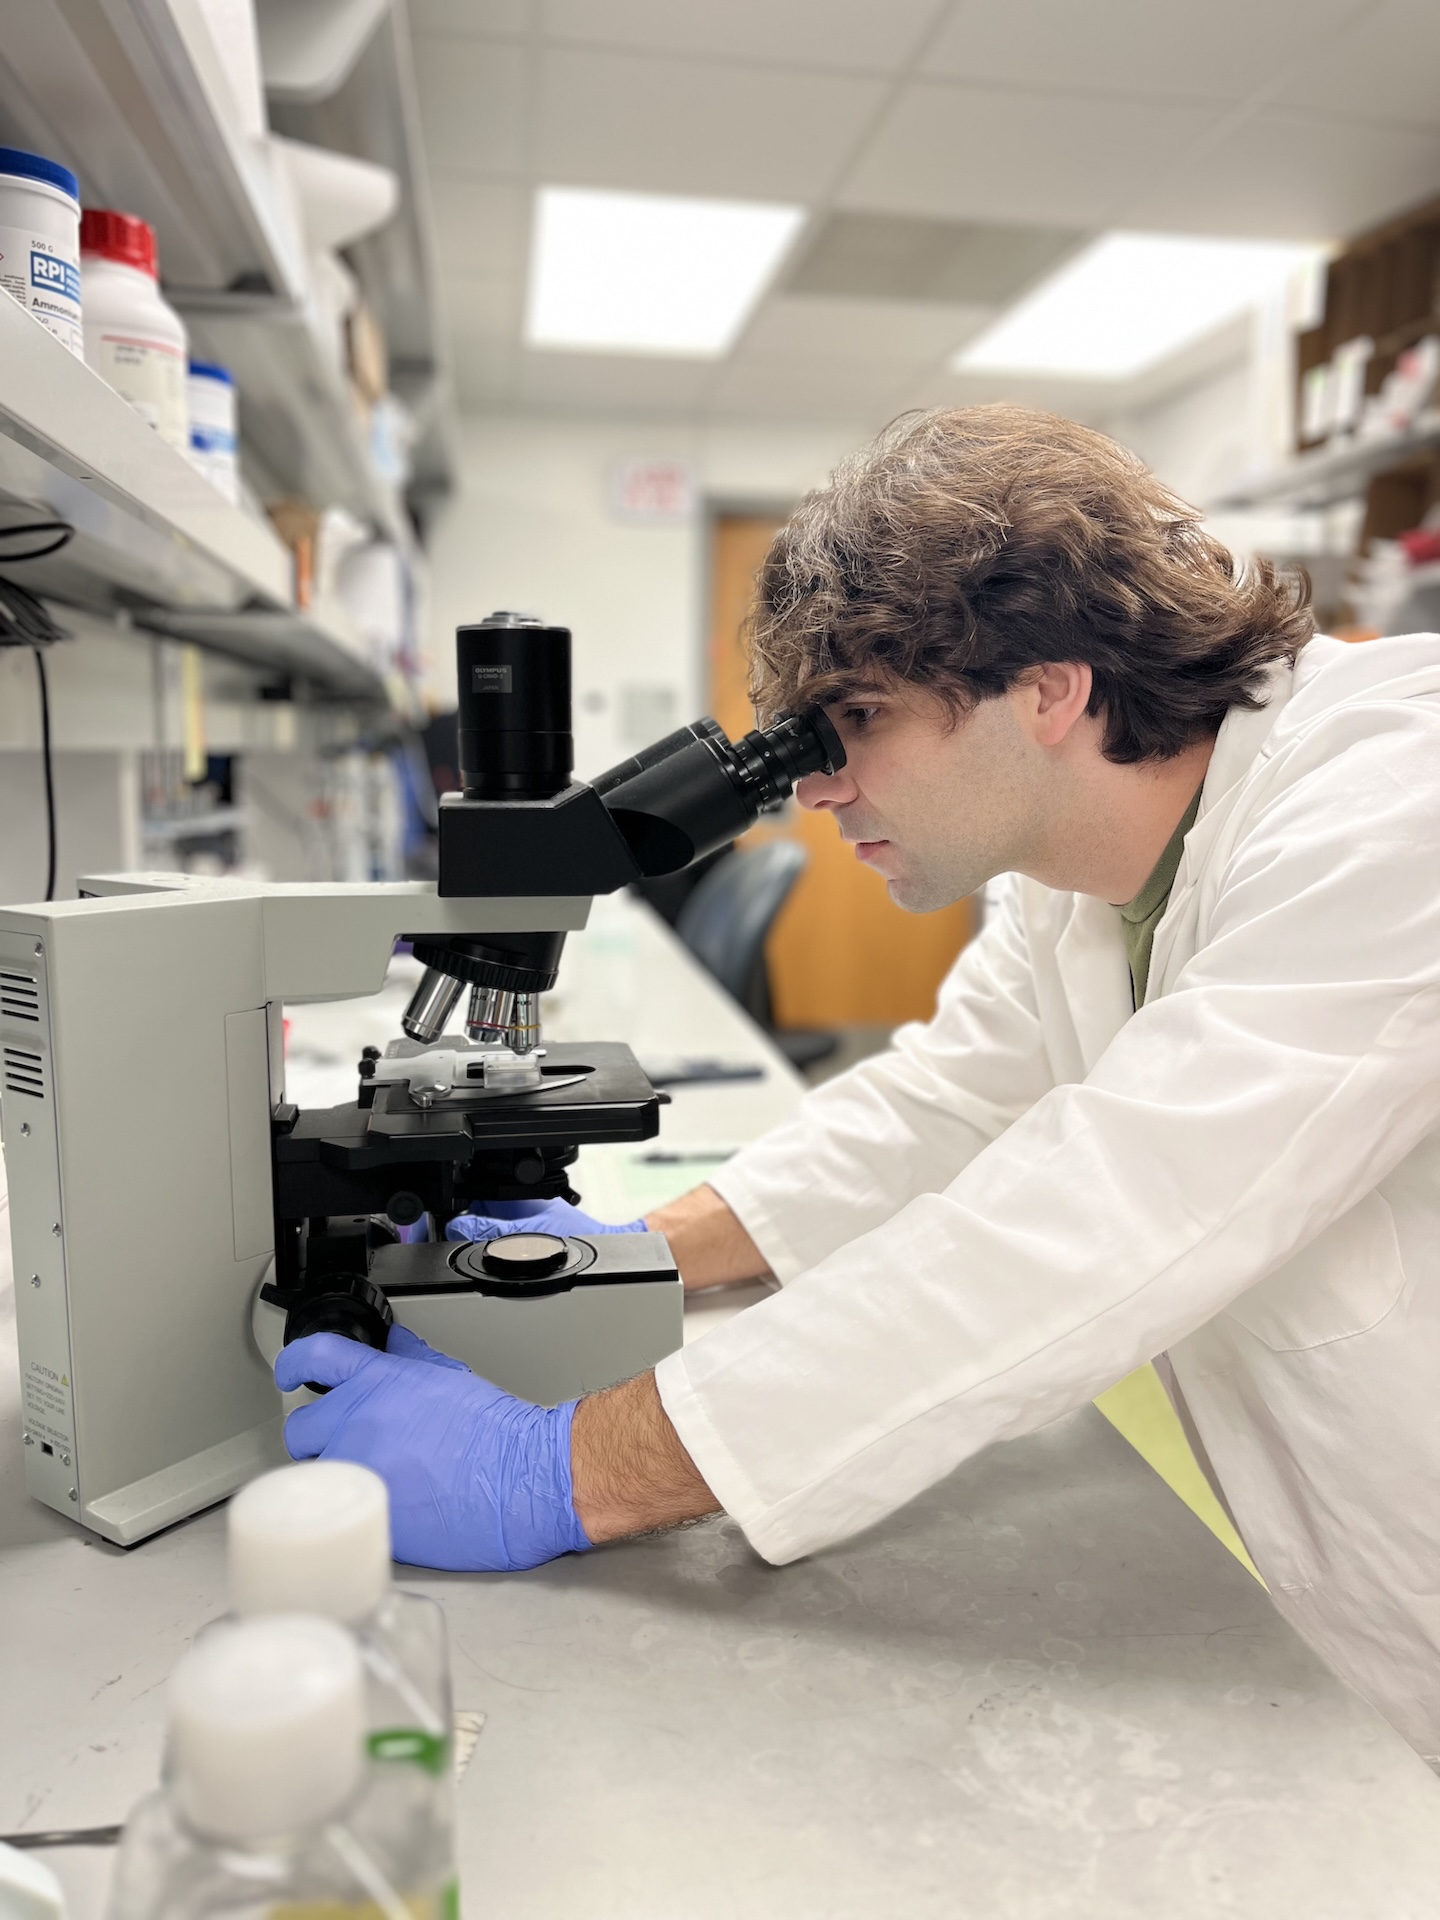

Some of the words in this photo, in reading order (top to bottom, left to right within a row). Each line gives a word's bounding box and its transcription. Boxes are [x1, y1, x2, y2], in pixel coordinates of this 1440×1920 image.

[31, 240, 46, 251] 500
[33, 256, 65, 283] RPI
[30, 1361, 59, 1382] CAUTION
